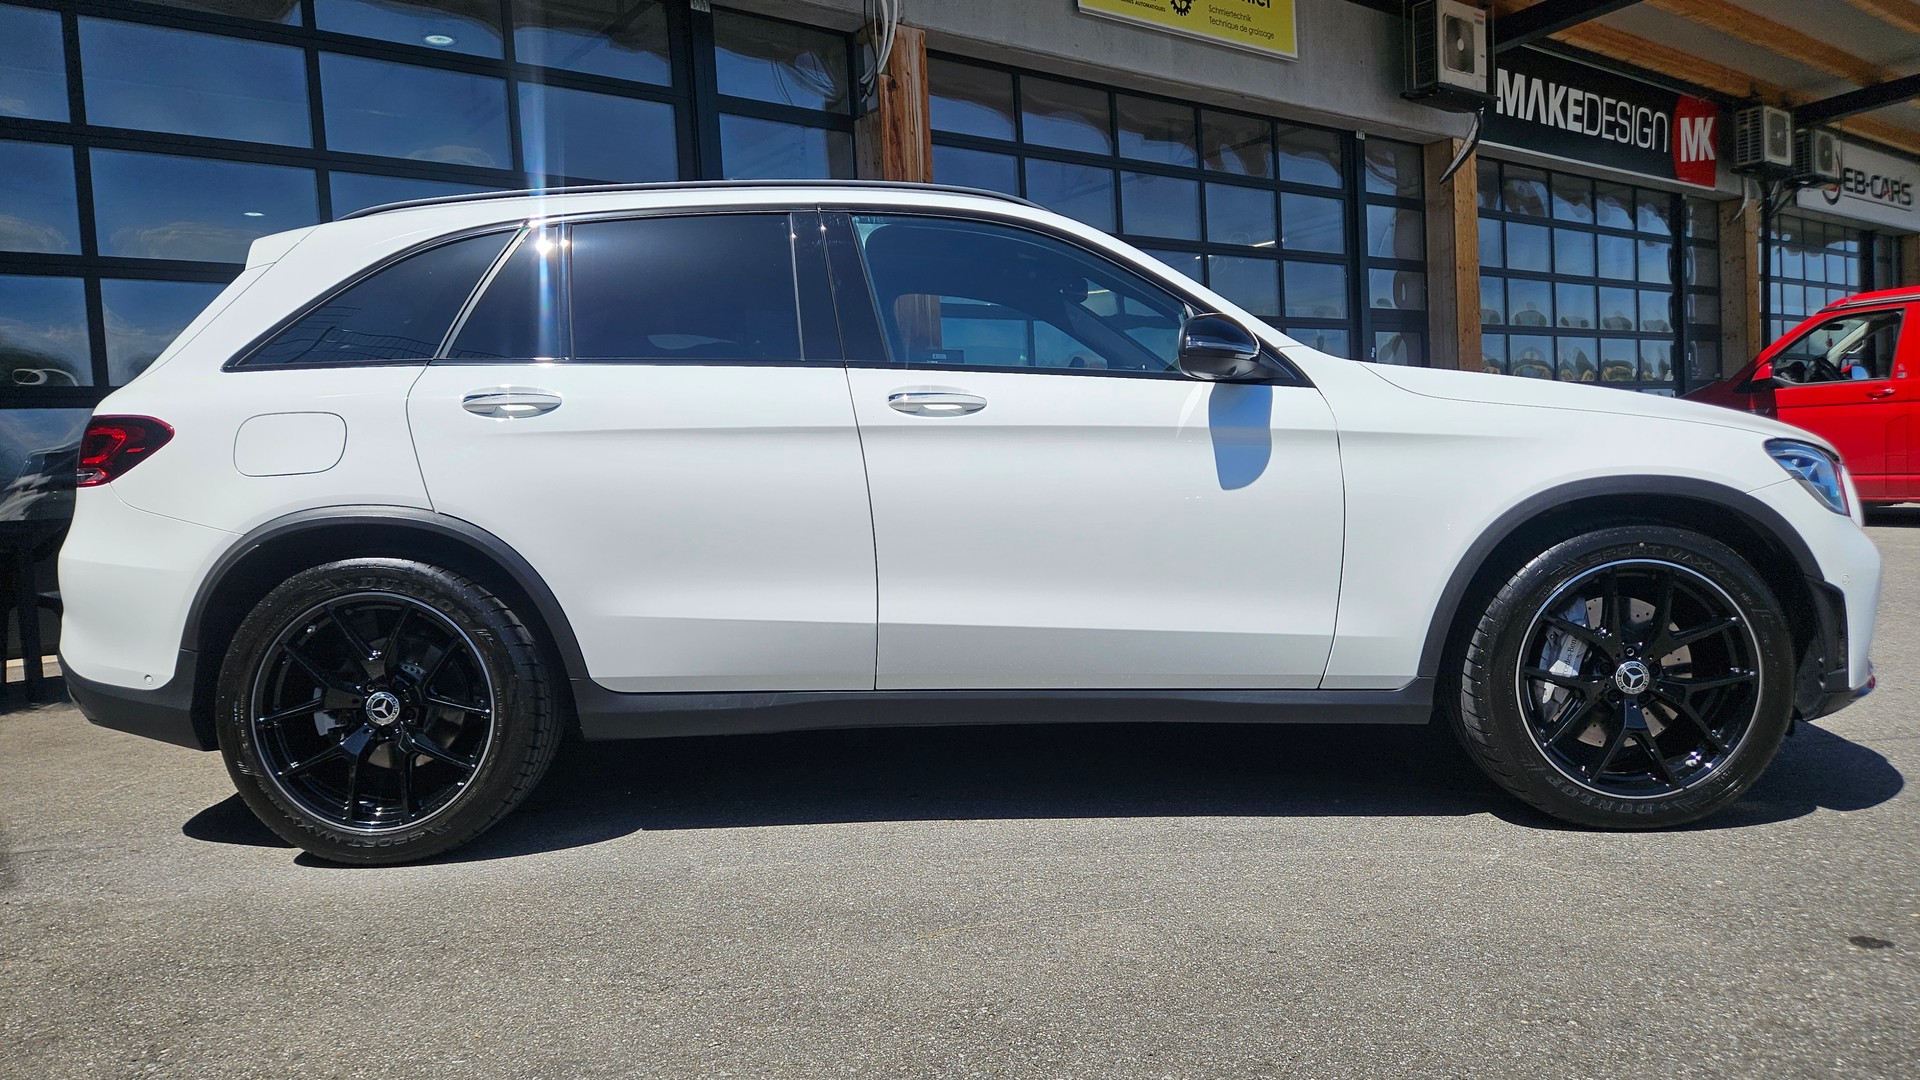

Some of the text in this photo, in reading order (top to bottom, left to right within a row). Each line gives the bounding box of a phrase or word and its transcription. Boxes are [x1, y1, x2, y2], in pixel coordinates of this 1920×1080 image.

[1208, 4, 1252, 22] Schmiertechnik
[1209, 16, 1275, 39] Technique de graissage
[1496, 68, 1668, 152] MAKEDESIGN
[1680, 117, 1715, 162] MK
[357, 577, 471, 626] DUNLOP
[1545, 774, 1654, 813] DUNLOP
